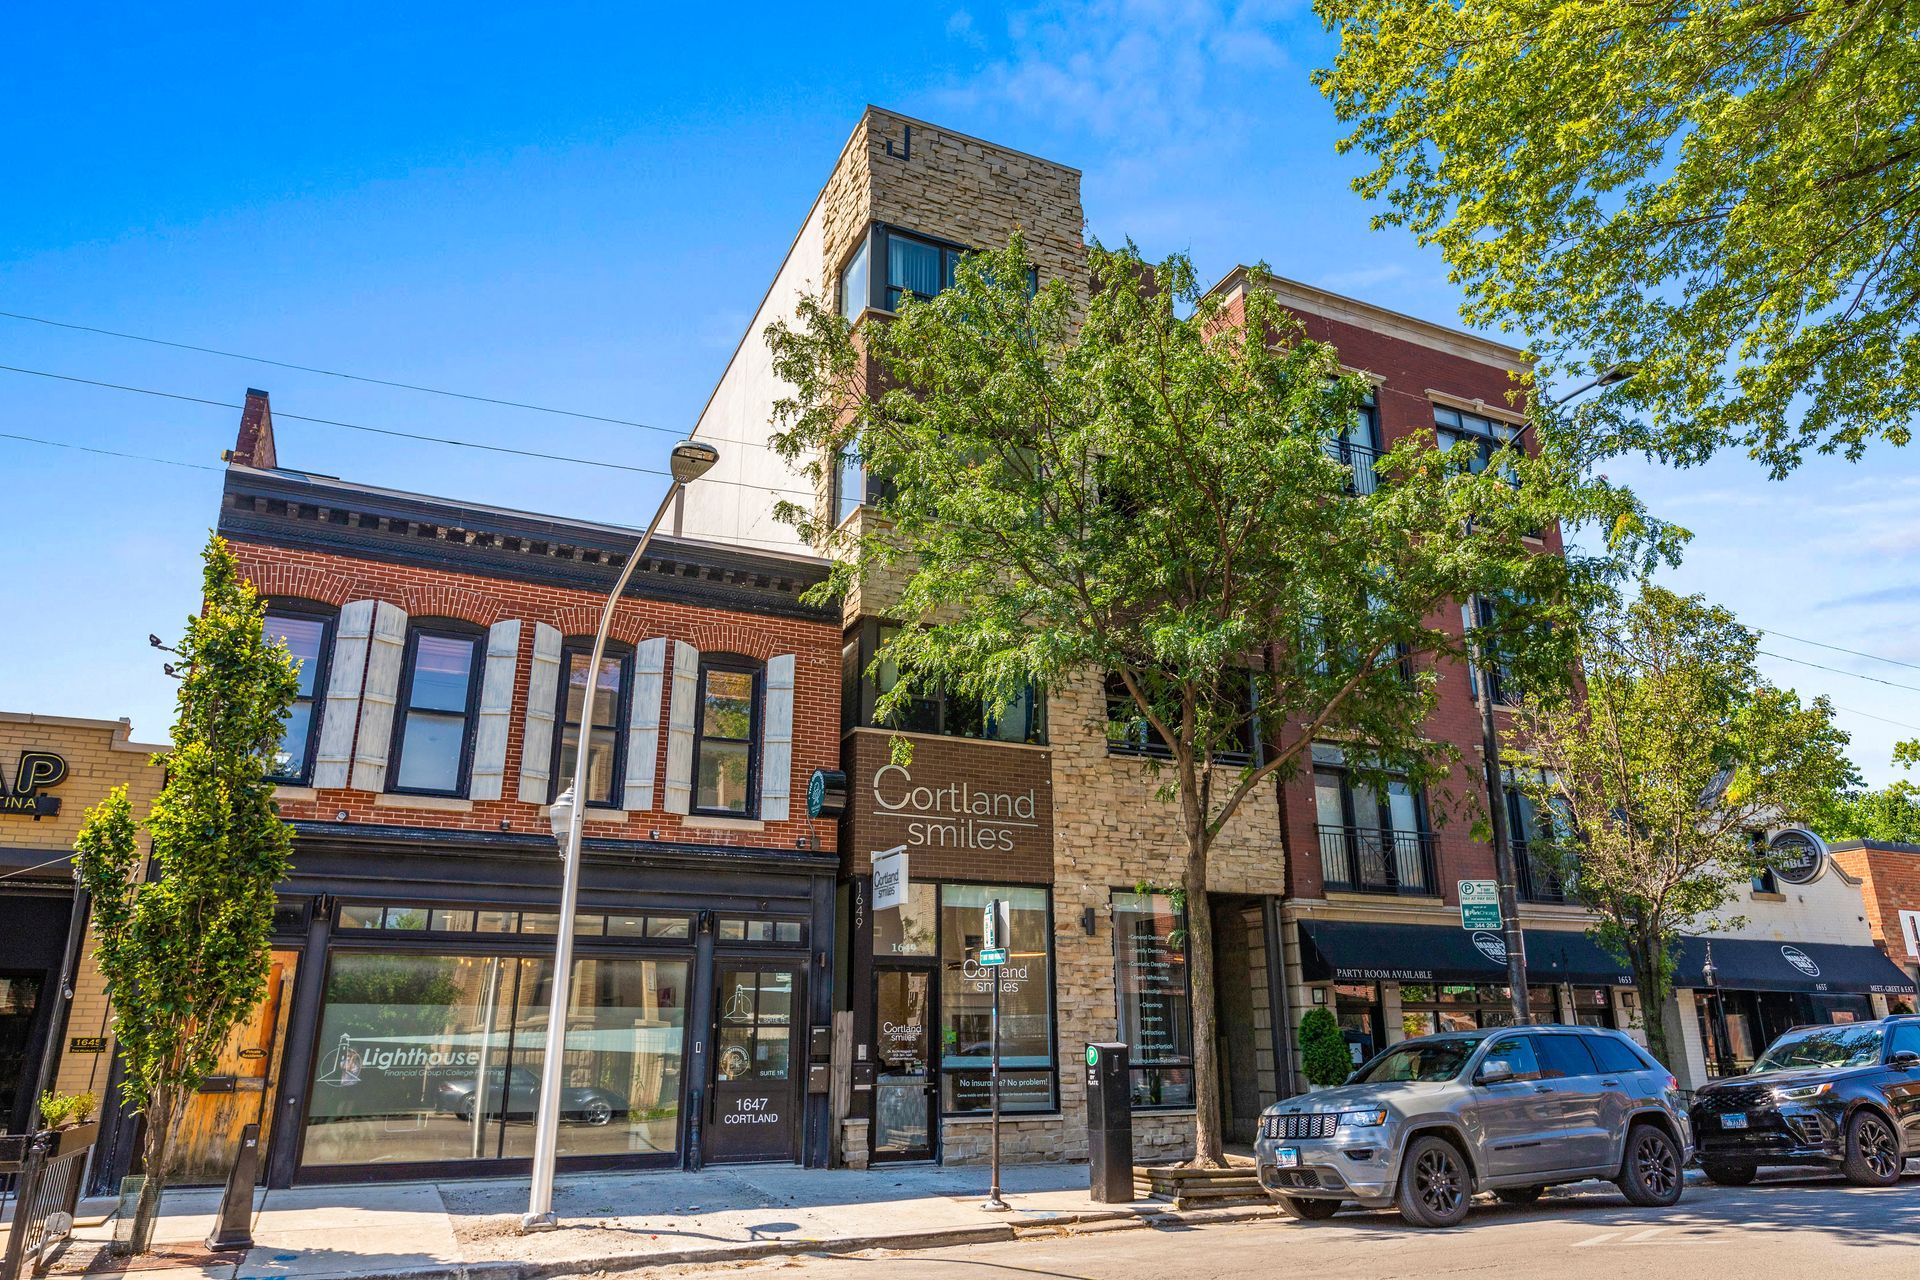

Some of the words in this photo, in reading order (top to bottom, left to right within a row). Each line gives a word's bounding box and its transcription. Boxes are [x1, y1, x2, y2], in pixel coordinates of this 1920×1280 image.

[873, 764, 1036, 819] Cortland
[907, 818, 1014, 851] smiles
[874, 868, 899, 888] Cortland
[878, 886, 895, 899] smiles
[855, 881, 864, 929] 1649
[891, 943, 917, 953] 1649
[1336, 968, 1363, 978] PARTY
[1364, 969, 1390, 979] ROOM
[1392, 970, 1433, 979] AVAILABLE
[1618, 976, 1632, 984] 1653
[976, 980, 1019, 993] smles
[883, 1021, 922, 1033] Cortland
[362, 1047, 480, 1070] Lighthouse
[384, 1069, 417, 1077] Financial
[418, 1069, 441, 1077] Group
[446, 1069, 474, 1077] College
[960, 1079, 970, 1087] No
[1007, 1079, 1018, 1087] No
[1018, 1078, 1048, 1087] problem!
[736, 1097, 769, 1111] 1647
[724, 1113, 779, 1124] CORTLAND
